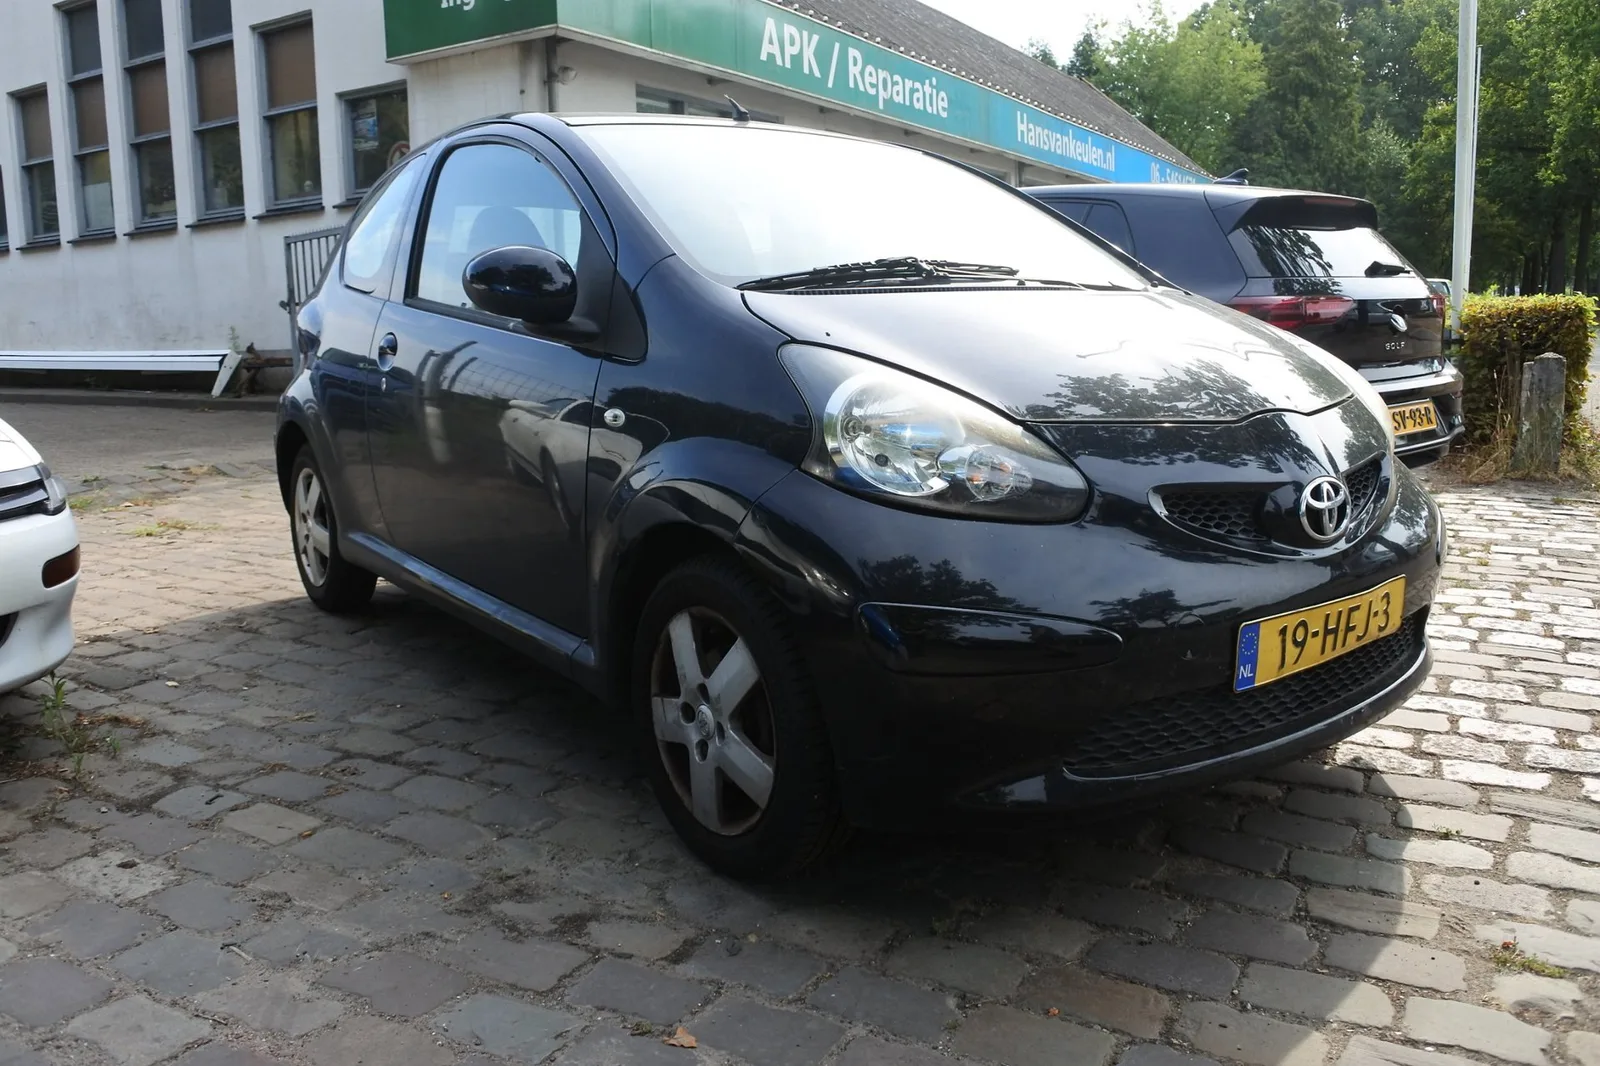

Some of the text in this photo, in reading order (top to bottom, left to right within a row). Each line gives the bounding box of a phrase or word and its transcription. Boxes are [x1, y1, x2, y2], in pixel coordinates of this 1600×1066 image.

[760, 17, 949, 119] APK / Reparatie
[1016, 110, 1116, 173] Hansvankeulen.nl
[1150, 161, 1160, 184] 06
[1385, 341, 1406, 350] GOLF
[1278, 590, 1391, 672] 19-HFJ-3
[1238, 663, 1254, 681] NL
